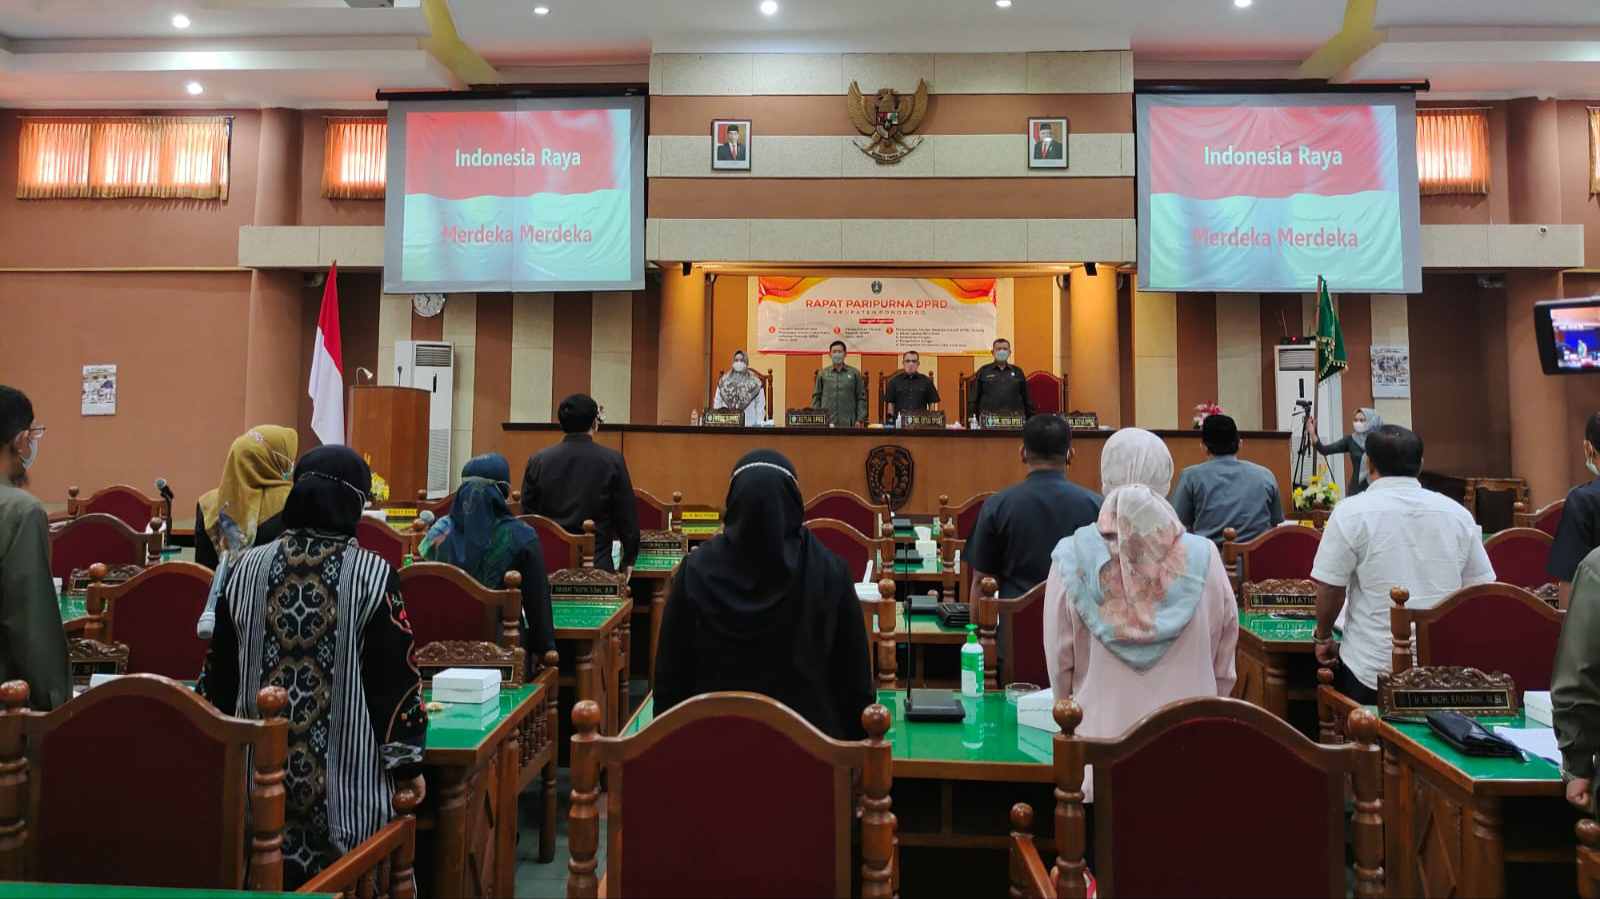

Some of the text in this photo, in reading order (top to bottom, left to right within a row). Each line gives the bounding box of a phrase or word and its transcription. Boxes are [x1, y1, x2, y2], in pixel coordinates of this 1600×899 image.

[455, 148, 581, 170] Indonesia Raya
[1204, 145, 1342, 170] Indonesia Raya
[441, 224, 592, 243] Merdeka Merdeka
[1193, 227, 1358, 247] Merdeka Merdeka
[806, 300, 948, 309] RAPAT PARIPURNA DPRD
